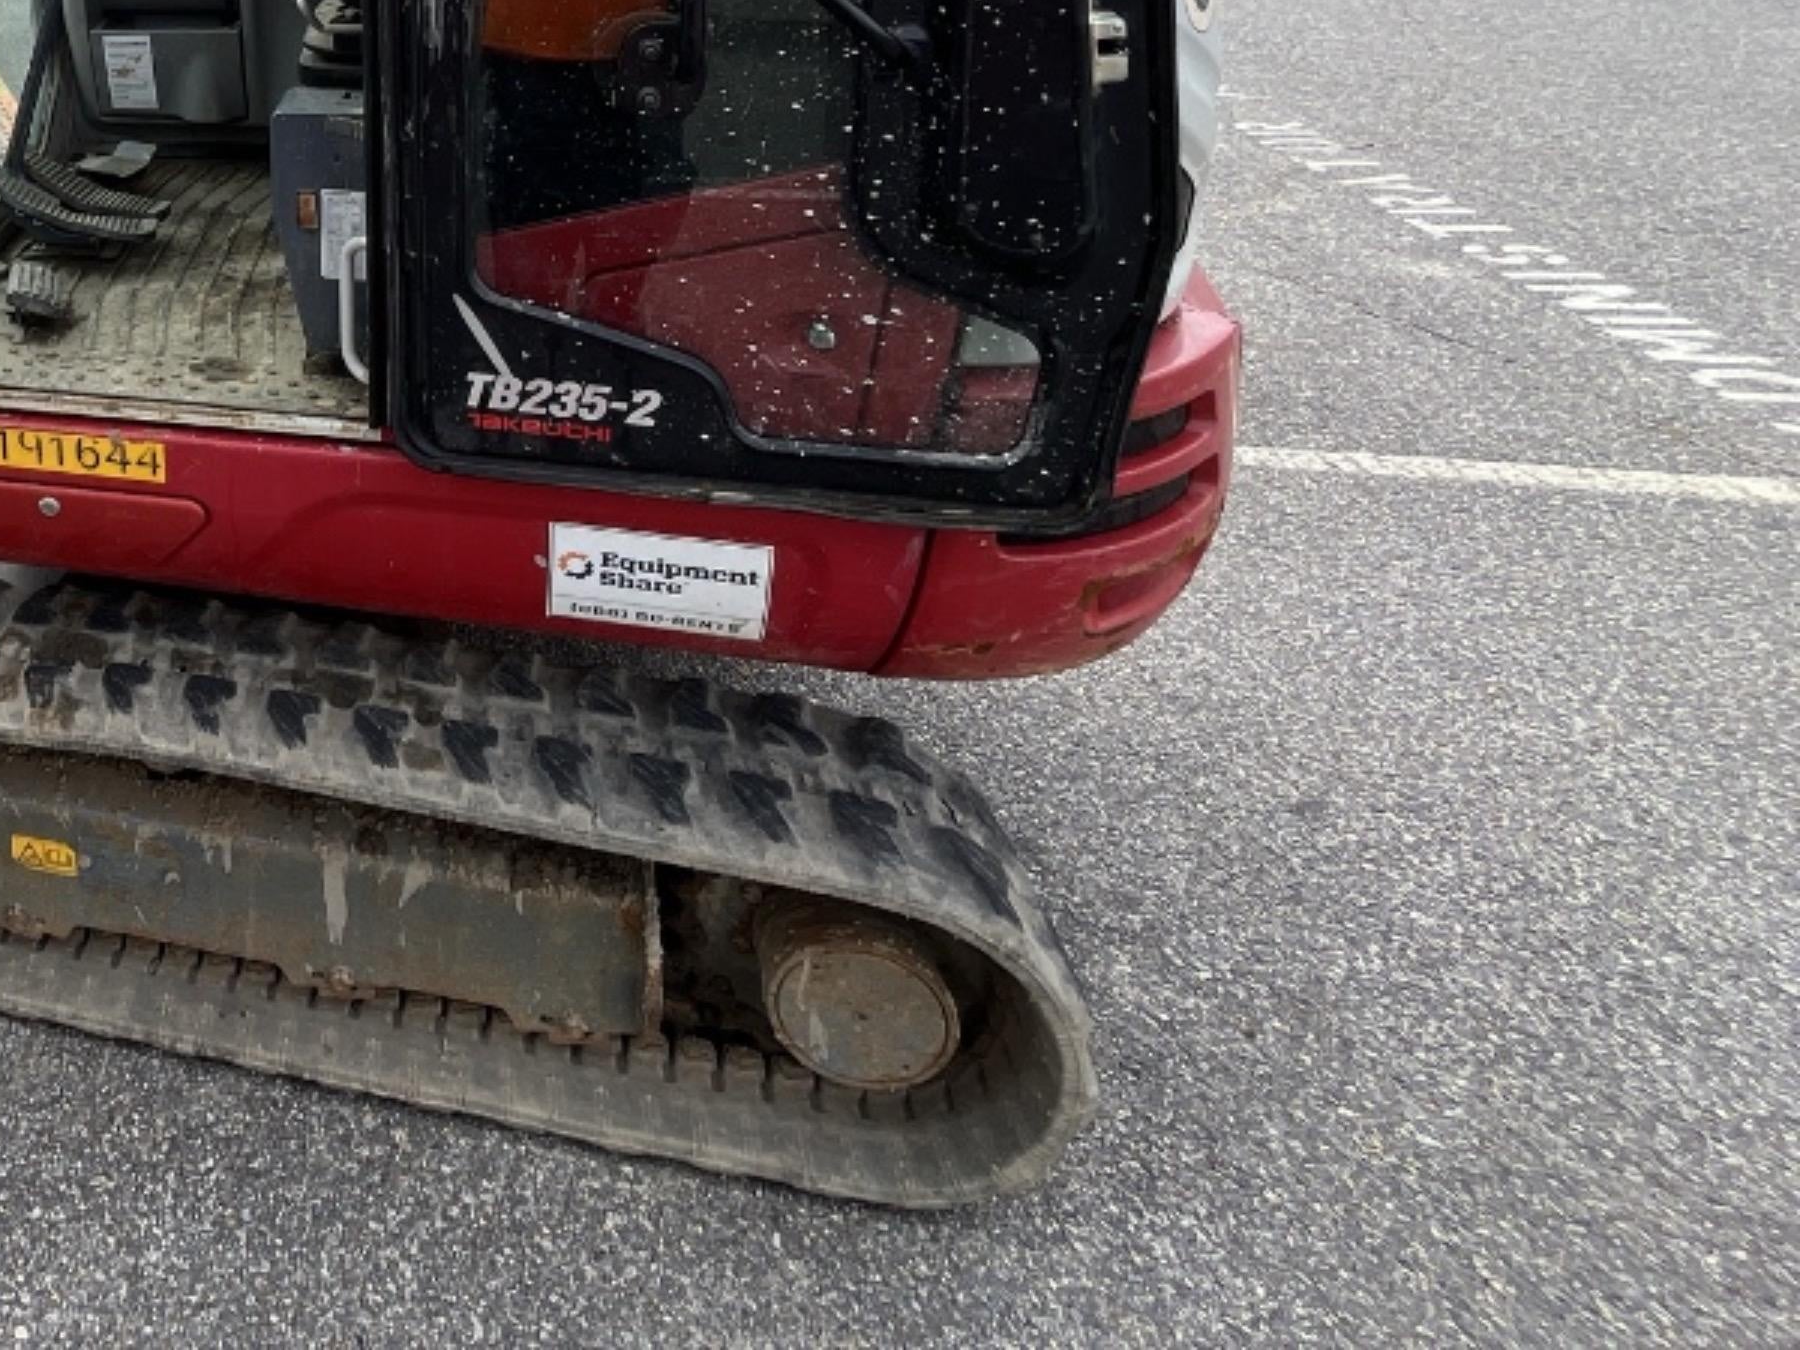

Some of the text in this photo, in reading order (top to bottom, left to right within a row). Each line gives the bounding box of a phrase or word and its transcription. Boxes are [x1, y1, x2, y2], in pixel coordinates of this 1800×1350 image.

[466, 371, 664, 427] TB235-2
[599, 571, 683, 595] Share
[600, 551, 760, 587] Equipment
